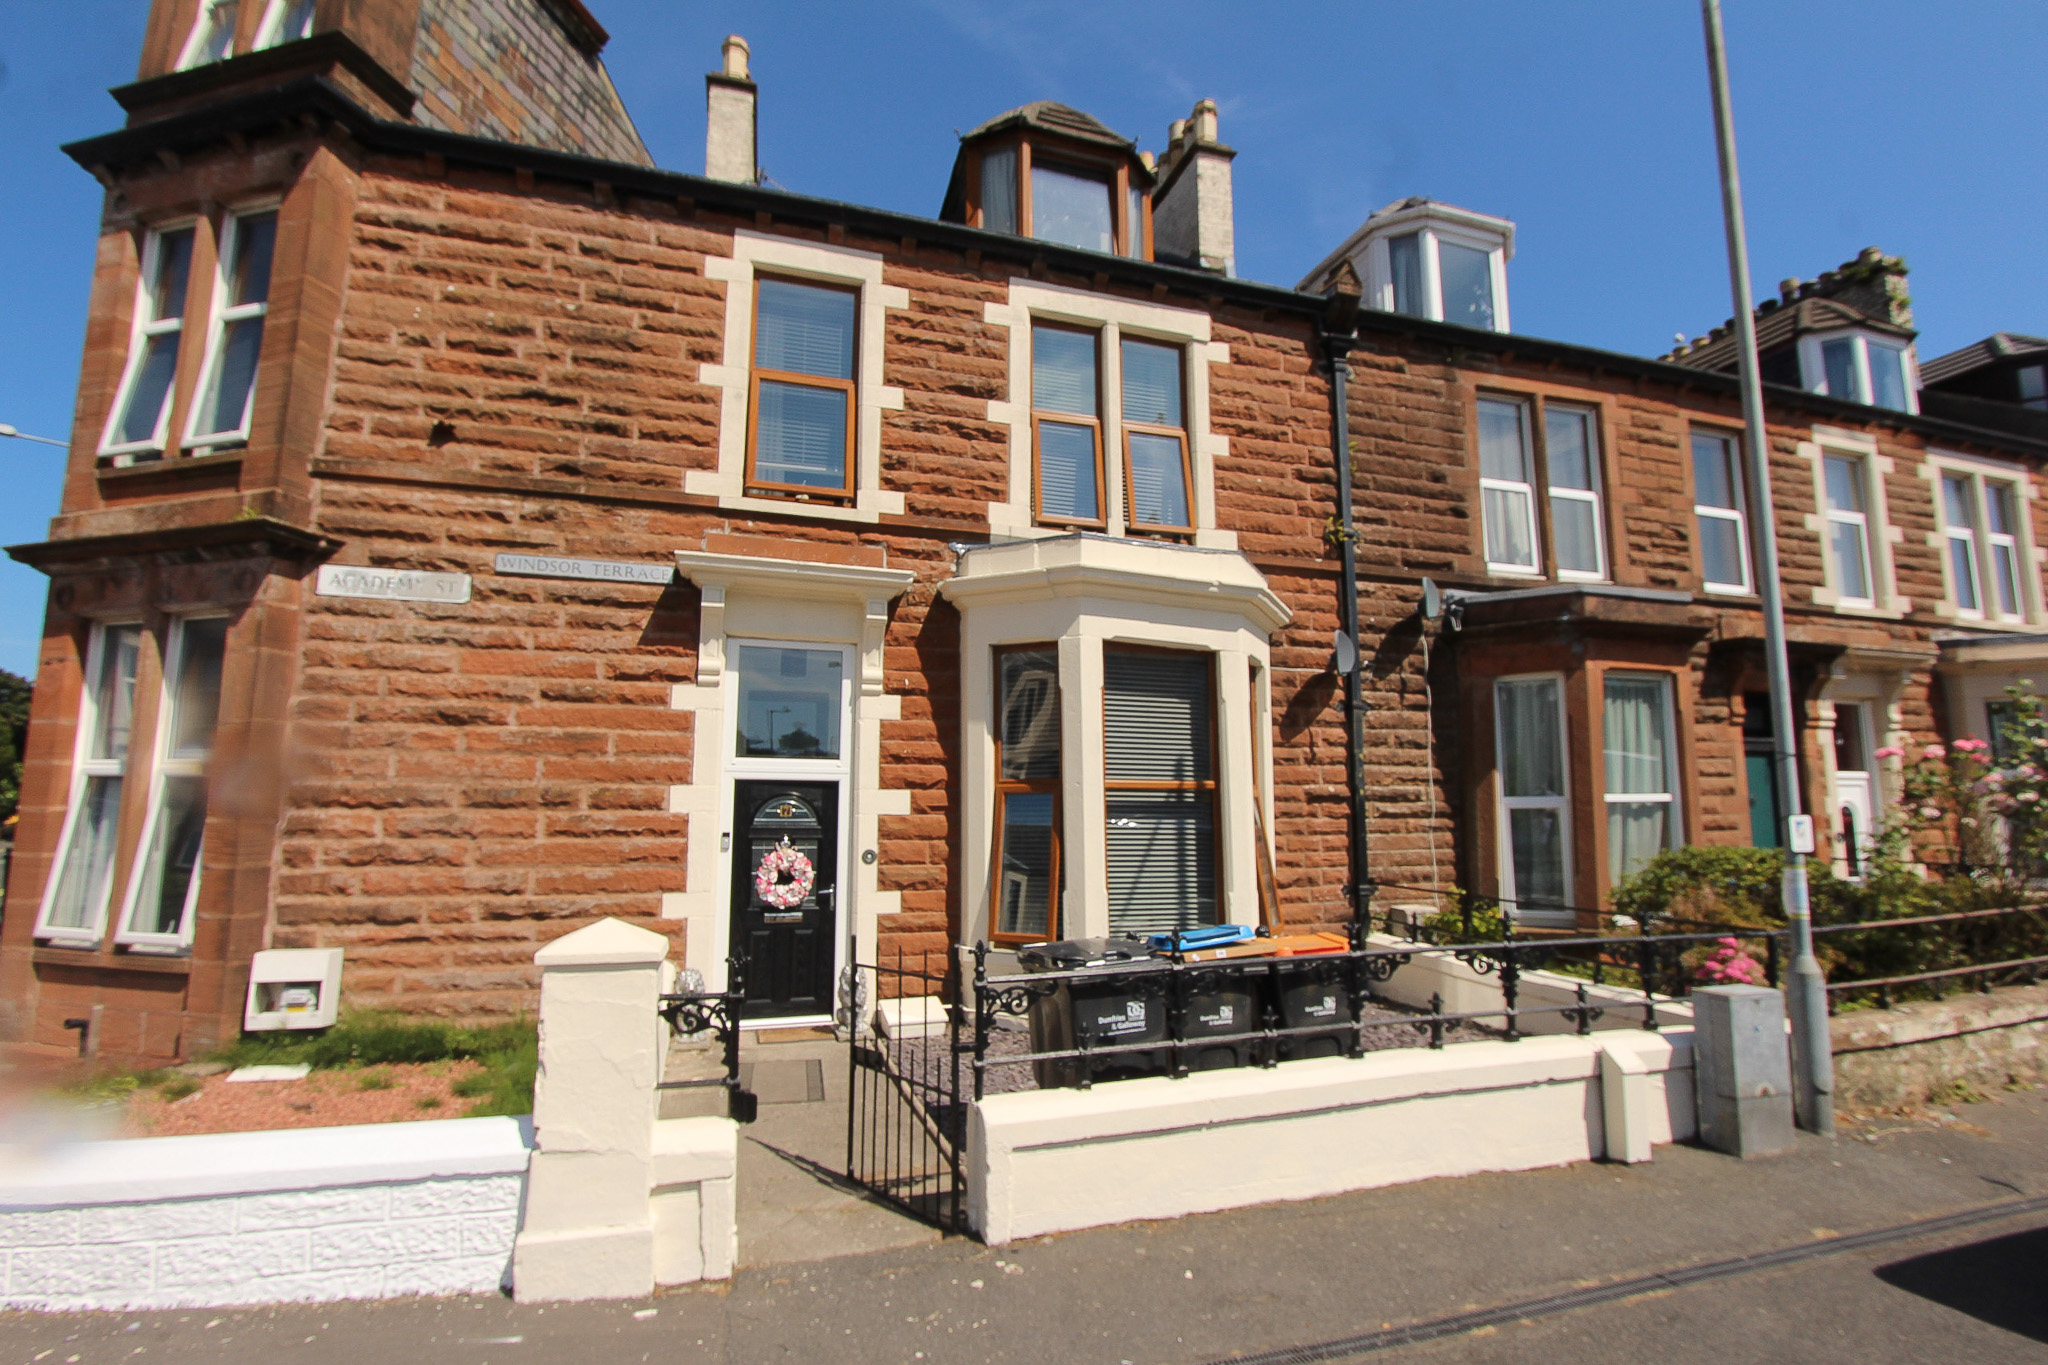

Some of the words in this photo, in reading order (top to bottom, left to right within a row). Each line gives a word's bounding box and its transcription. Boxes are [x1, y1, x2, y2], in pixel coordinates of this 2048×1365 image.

[501, 557, 582, 575] WINDSOR
[592, 563, 669, 581] TERRACE
[435, 579, 459, 593] ST
